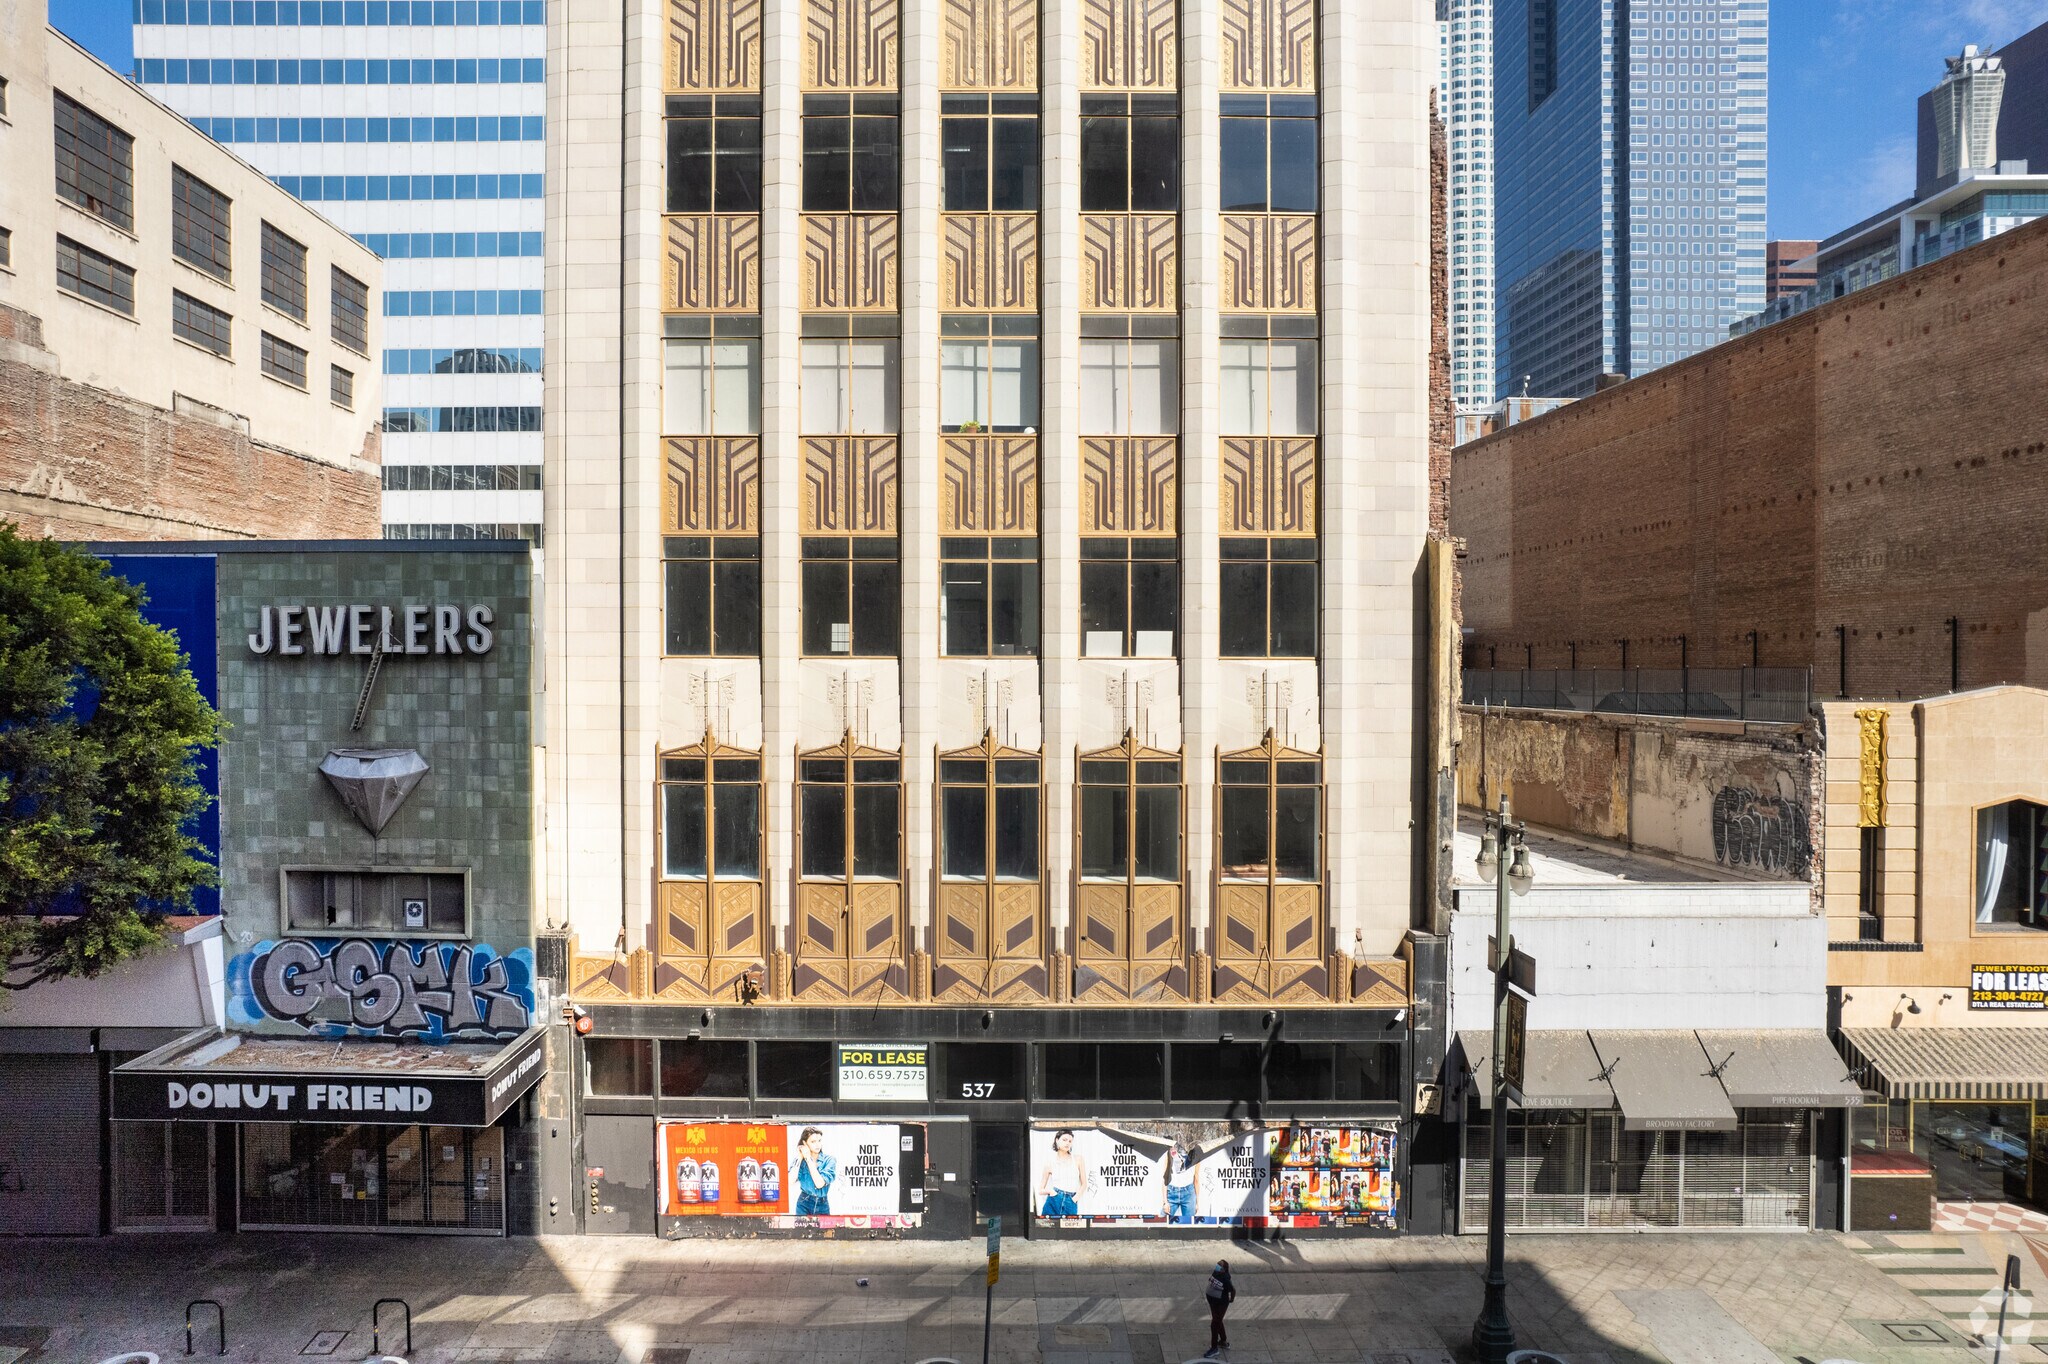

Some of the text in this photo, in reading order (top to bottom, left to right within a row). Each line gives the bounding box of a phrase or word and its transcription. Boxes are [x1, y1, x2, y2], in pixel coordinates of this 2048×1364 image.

[248, 604, 495, 655] JEWELERS
[1972, 972, 2006, 991] FOR
[1972, 991, 2045, 1001] 213-304-4727
[842, 1052, 926, 1065] FOR LEASE
[491, 1048, 541, 1103] DONUT FRIEND
[842, 1070, 925, 1080] 310.659.7575
[961, 1082, 995, 1098] 537
[168, 1081, 432, 1112] DONUT FRIEND
[1772, 1096, 1819, 1105] PIPE/HOOKAH
[1844, 1096, 1861, 1106] 535
[1540, 1097, 1573, 1107] BOUTIQUE
[1645, 1119, 1716, 1128] BROADWAY FACTORY
[859, 1144, 879, 1154] NOT
[1114, 1144, 1135, 1154] NOT
[1232, 1146, 1252, 1156] NOT
[857, 1155, 881, 1165] YOUR
[1112, 1155, 1137, 1165] YOUR
[1229, 1157, 1254, 1167] YOUR
[844, 1166, 893, 1176] MOTHER'S
[1100, 1166, 1149, 1176] MOTHER'S
[1217, 1168, 1266, 1178] MOTHER'S
[850, 1177, 889, 1187] TIFFANY
[1104, 1177, 1145, 1187] TIFFANY
[1222, 1179, 1262, 1189] TIFFANY
